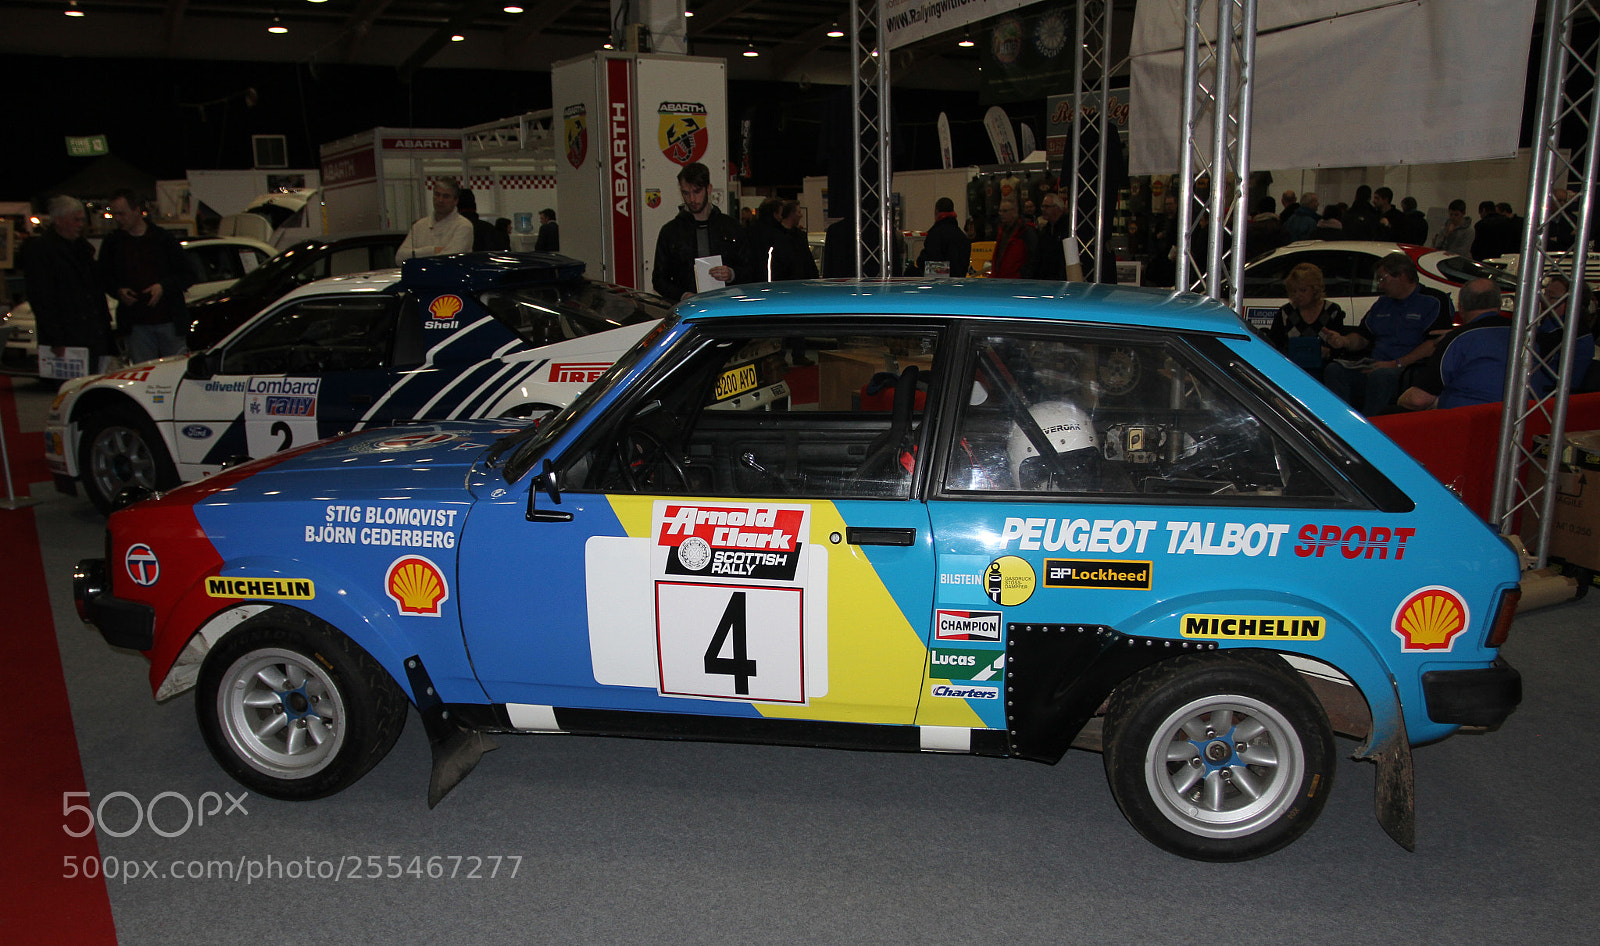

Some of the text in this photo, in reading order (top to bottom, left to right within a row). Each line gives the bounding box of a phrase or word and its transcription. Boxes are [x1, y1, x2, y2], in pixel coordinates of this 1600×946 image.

[659, 104, 705, 113] ABARTH
[395, 140, 450, 149] ABARTH
[612, 102, 629, 217] ABARTH
[424, 320, 459, 330] Shell
[205, 381, 244, 392] olivetti
[247, 377, 320, 395] Lombard
[715, 366, 757, 397] B200 AYD
[266, 396, 315, 416] rally
[187, 426, 208, 438] Ford
[271, 421, 293, 452] 2
[1043, 423, 1081, 435] VEROAK
[325, 505, 457, 527] STIG BLOMQVIST
[663, 507, 778, 536] Arnold
[305, 523, 455, 549] BJÖRN CEDERBERG
[711, 526, 793, 549] Clark
[1000, 516, 1417, 561] PEUGEOT TALBOT SPORT
[713, 551, 788, 567] SCOTTISH
[711, 562, 756, 576] RALLY
[209, 579, 311, 597] MICHELIN
[940, 573, 983, 586] BILSTEIN
[941, 619, 997, 633] CHAMPION
[1185, 617, 1320, 637] MICHELIN
[704, 591, 757, 695] 4
[931, 650, 976, 666] Lucas
[933, 685, 997, 699] Charters
